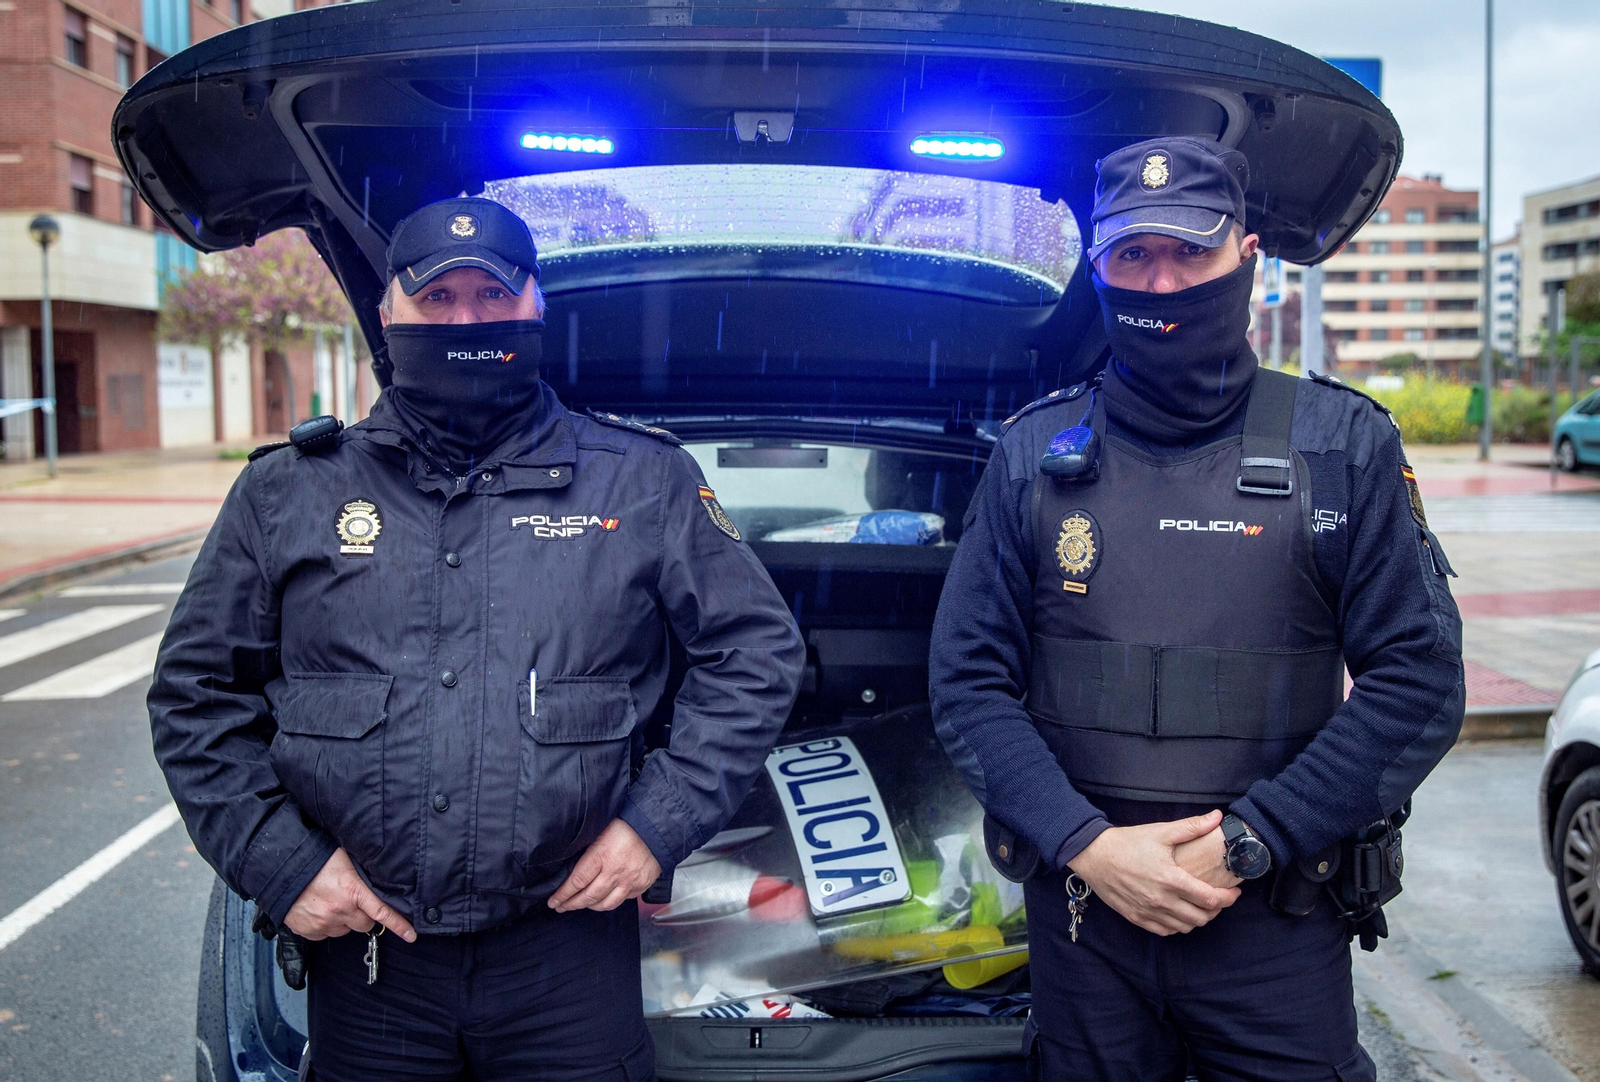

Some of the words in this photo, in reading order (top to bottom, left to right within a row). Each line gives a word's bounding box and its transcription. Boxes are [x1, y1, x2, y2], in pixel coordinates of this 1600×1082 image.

[1117, 314, 1164, 329] POLICIA
[447, 350, 505, 360] POLICIA
[511, 515, 603, 527] POLICIA
[1311, 508, 1348, 525] ICIA
[534, 526, 584, 537] CNP
[1159, 519, 1247, 532] POLICIA
[770, 739, 897, 908] POLICIA
